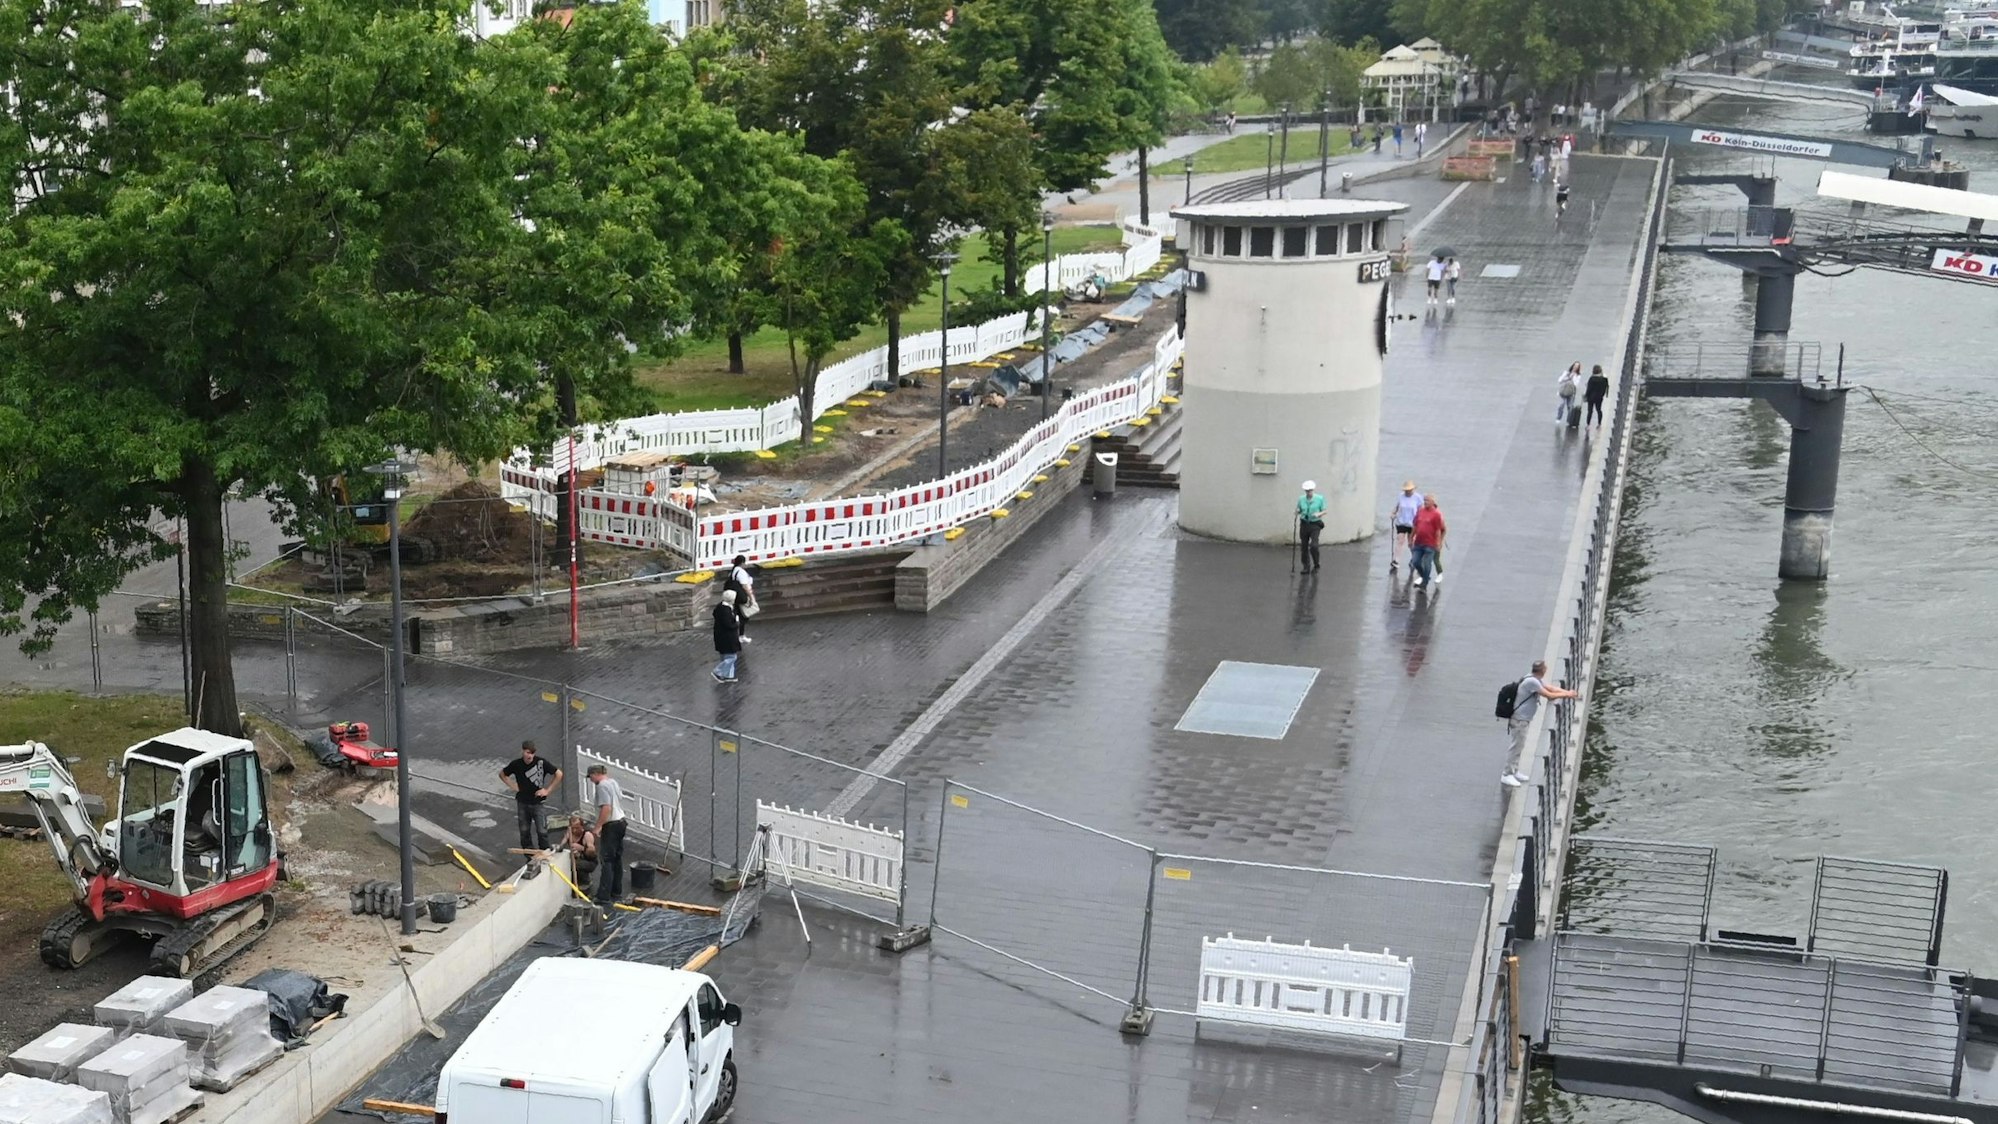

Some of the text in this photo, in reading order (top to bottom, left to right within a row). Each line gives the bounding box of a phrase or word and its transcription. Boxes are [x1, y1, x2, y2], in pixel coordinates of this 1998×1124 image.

[1701, 134, 1820, 154] KD Köln-Düsseldorfer
[1944, 257, 1983, 273] KD
